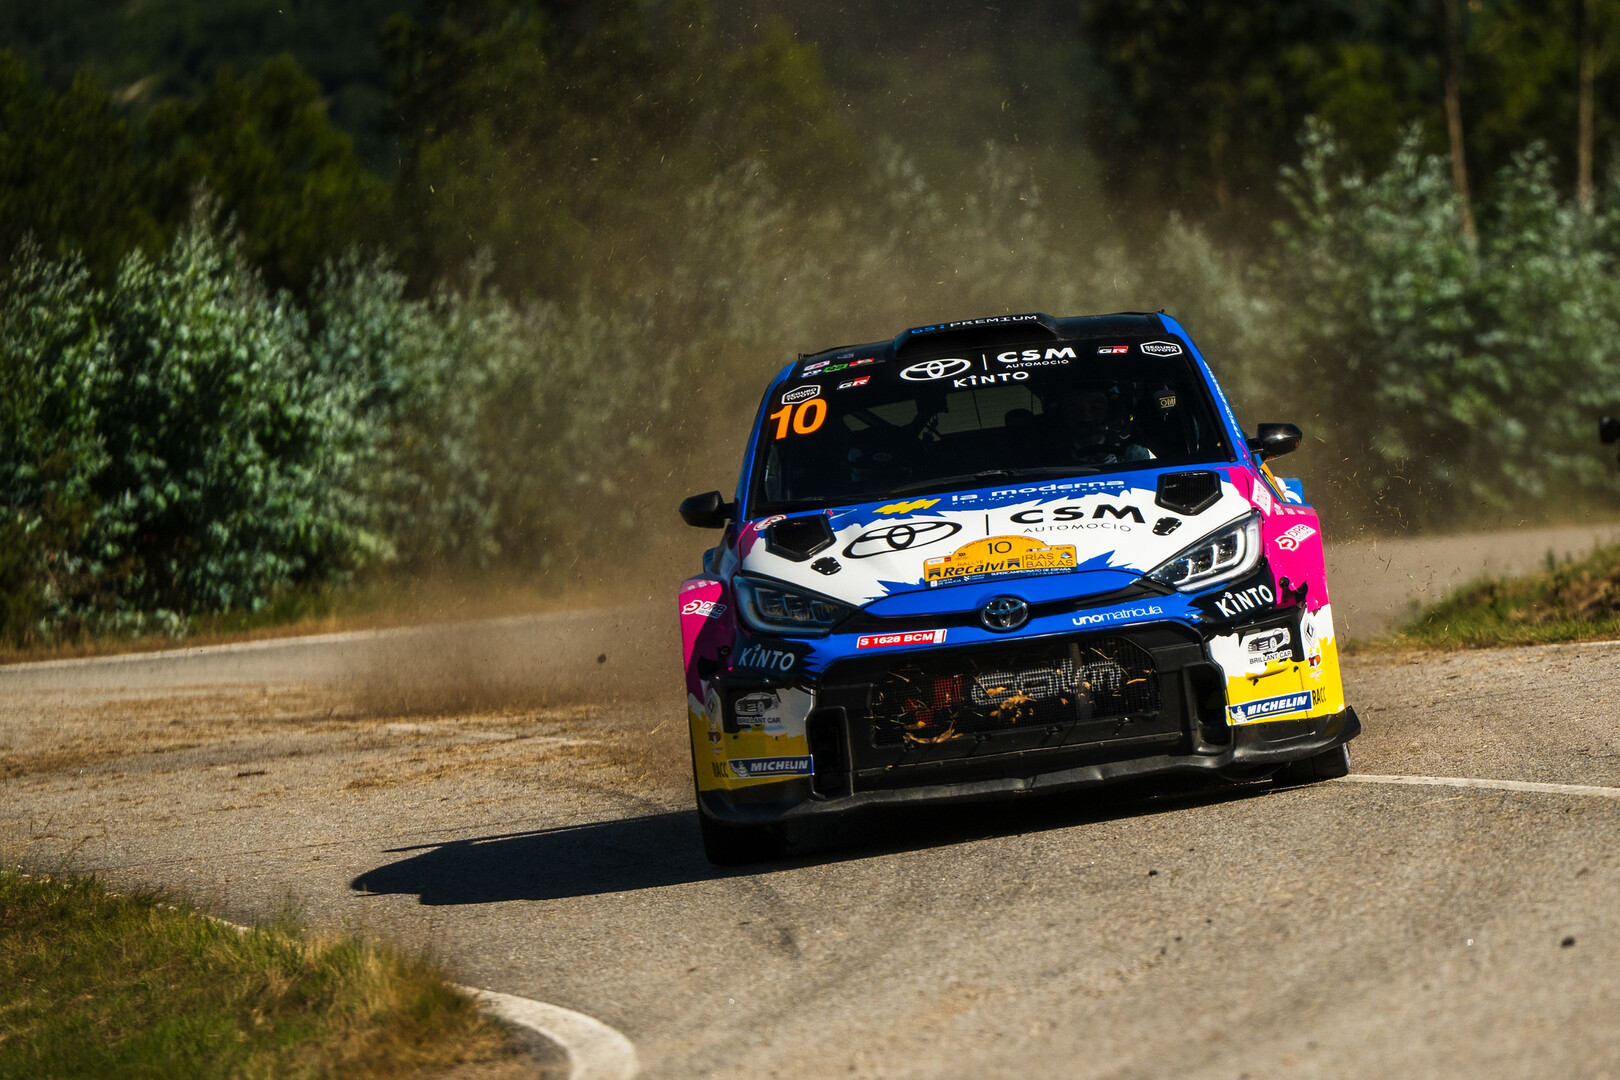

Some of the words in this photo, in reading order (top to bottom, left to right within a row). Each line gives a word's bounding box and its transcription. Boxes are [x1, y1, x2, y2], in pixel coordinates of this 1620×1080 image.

[950, 315, 1038, 327] PREMIUM
[997, 347, 1077, 363] CSM
[1099, 346, 1127, 354] GR
[839, 378, 870, 390] GR
[953, 371, 1029, 388] KINTO
[769, 398, 828, 440] 10
[952, 494, 978, 502] la
[991, 480, 1125, 497] moderna
[1010, 503, 1146, 524] CSM
[988, 541, 1012, 555] 10
[943, 561, 1005, 577] Recalvi
[1026, 559, 1074, 568] BAIXAS
[1215, 584, 1274, 618] KINTO
[1072, 605, 1163, 625] unomatricula
[860, 638, 869, 646] S
[904, 633, 934, 642] BCM
[738, 644, 795, 671] KINTO
[1249, 653, 1278, 665] BRILLANT
[1279, 650, 1292, 659] CAR
[1247, 695, 1308, 716] MICHELIN
[737, 716, 766, 725] BRILLANT
[767, 716, 781, 724] CAR
[751, 759, 809, 772] MICHELIN
